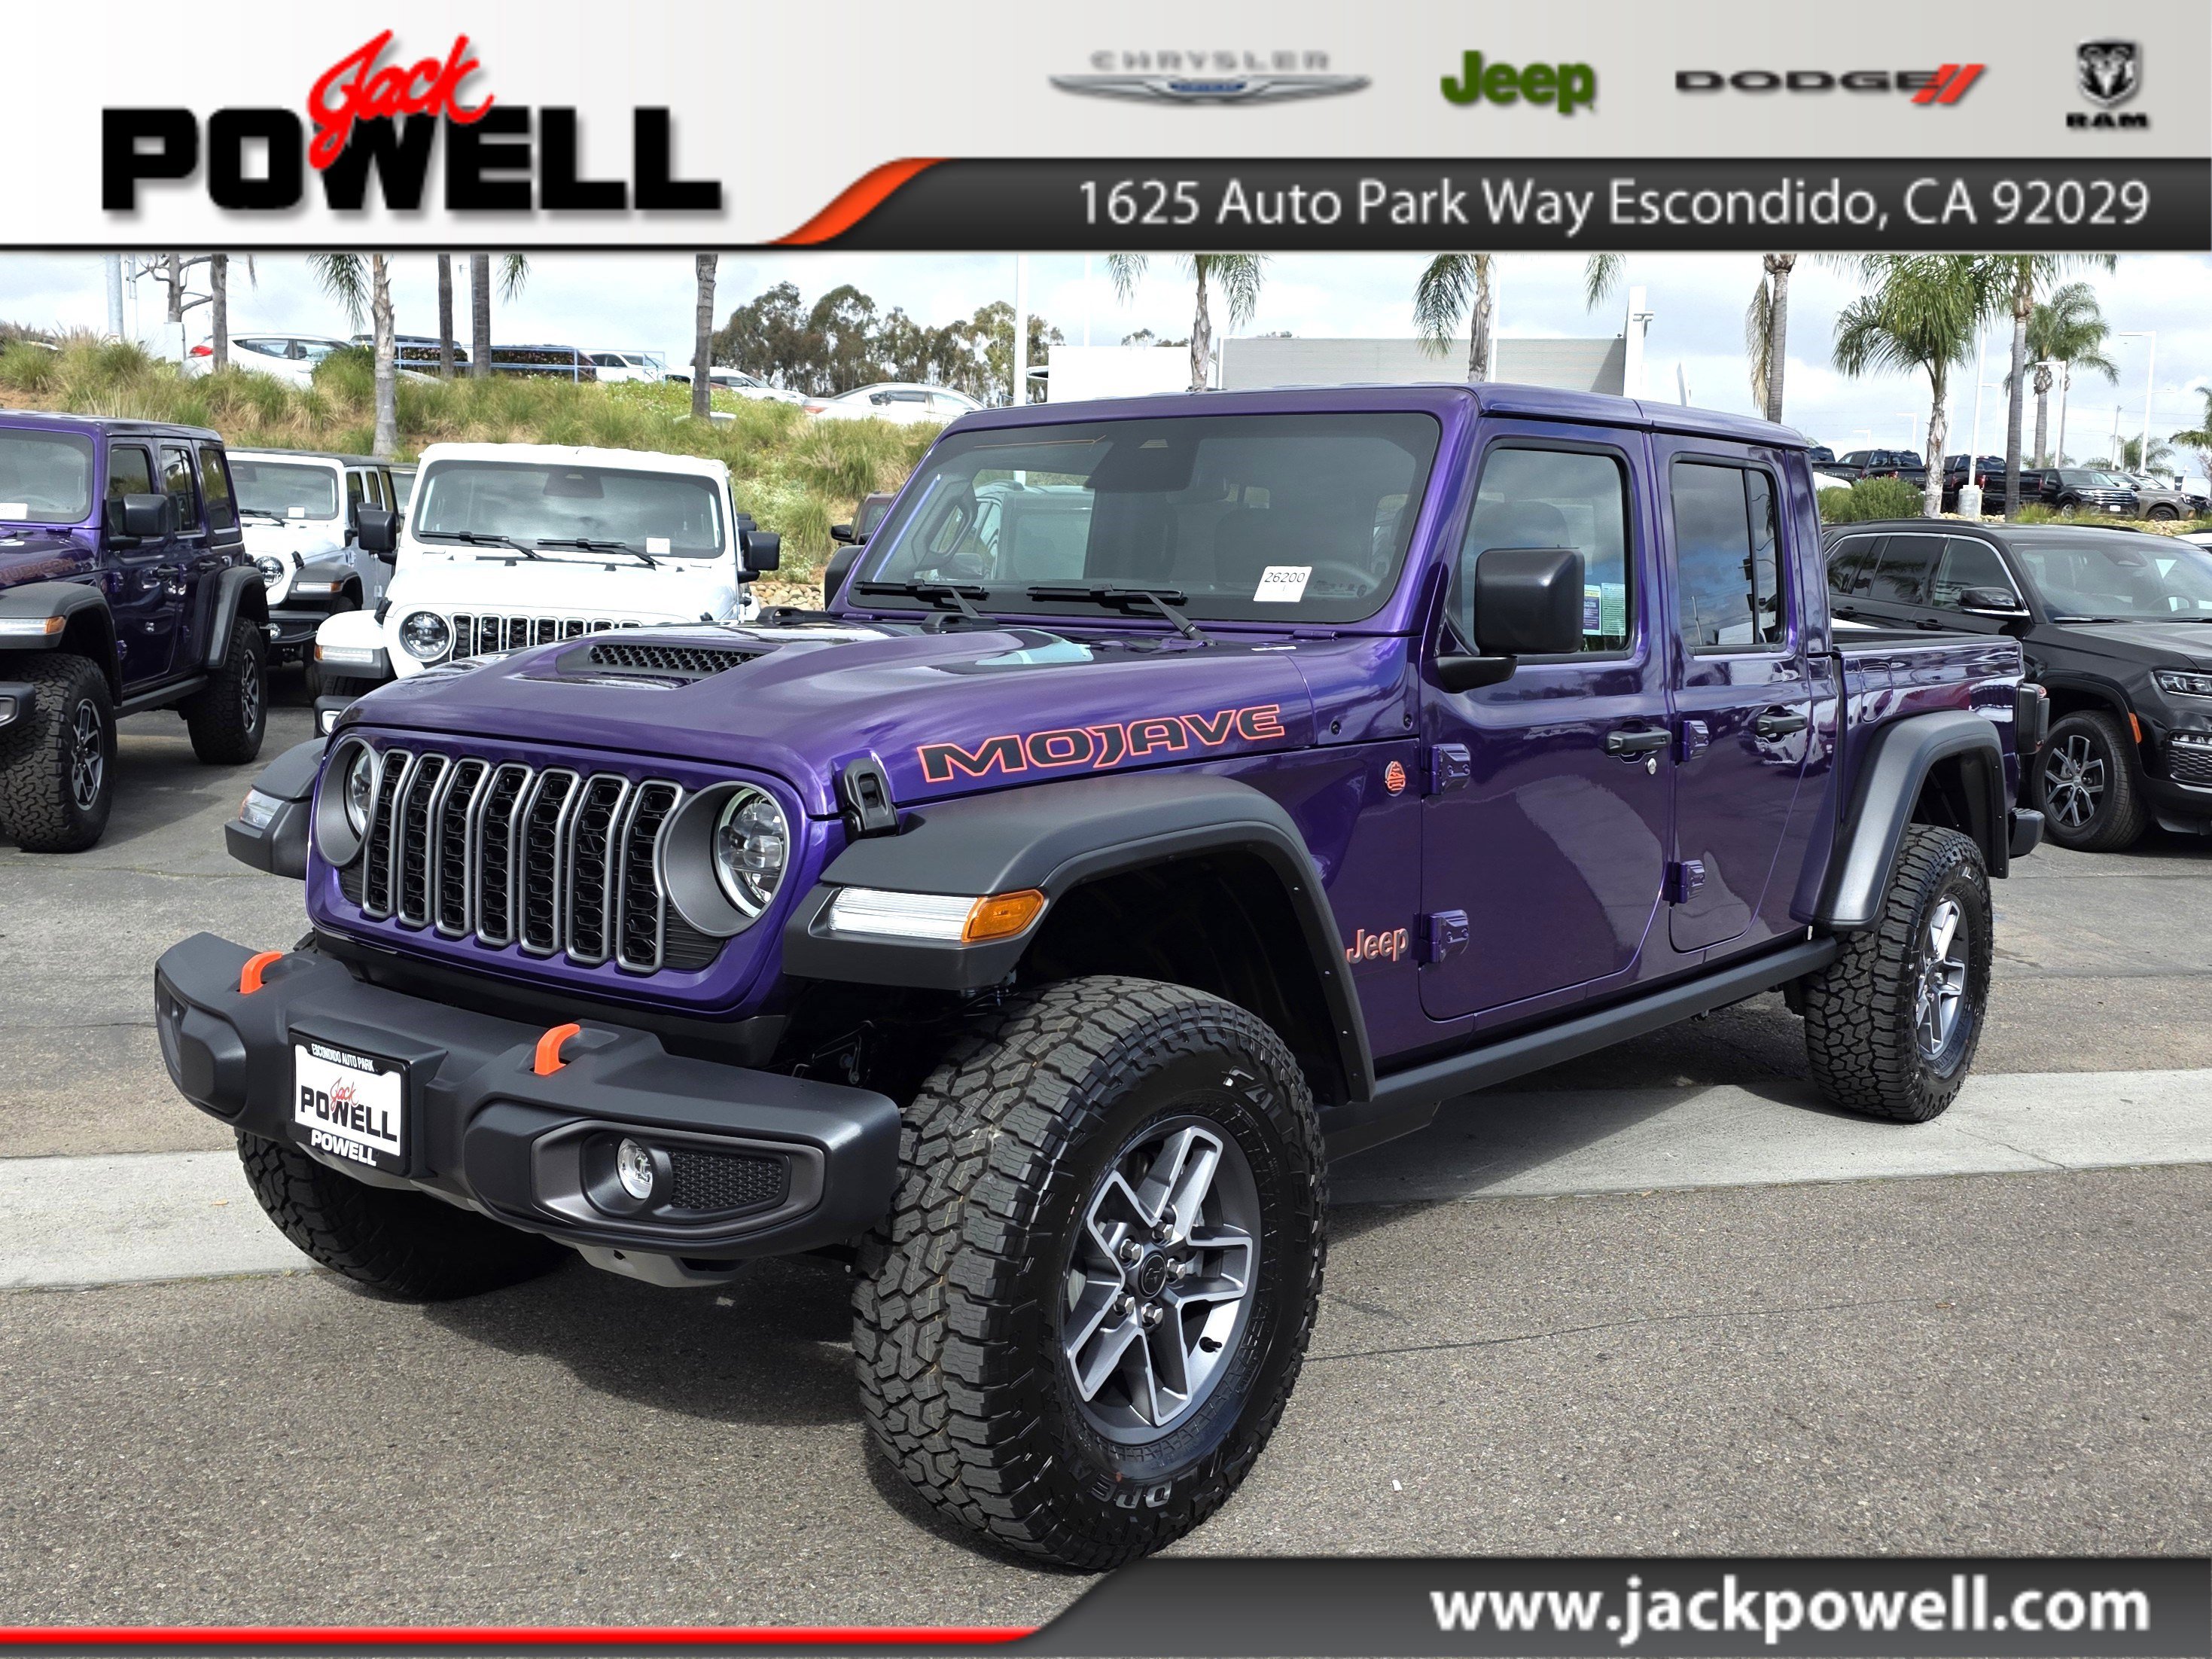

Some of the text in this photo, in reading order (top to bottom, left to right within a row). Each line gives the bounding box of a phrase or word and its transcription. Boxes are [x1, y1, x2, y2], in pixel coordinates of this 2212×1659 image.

[1264, 572, 1306, 583] 26200
[916, 704, 1285, 782] MOJAVE
[1346, 928, 1409, 964] Jeep
[342, 1053, 358, 1068] AUTO
[357, 1057, 375, 1072] PARK
[330, 1076, 359, 1112] Jack
[301, 1084, 398, 1142] POWELL
[311, 1129, 377, 1166] POWELL
